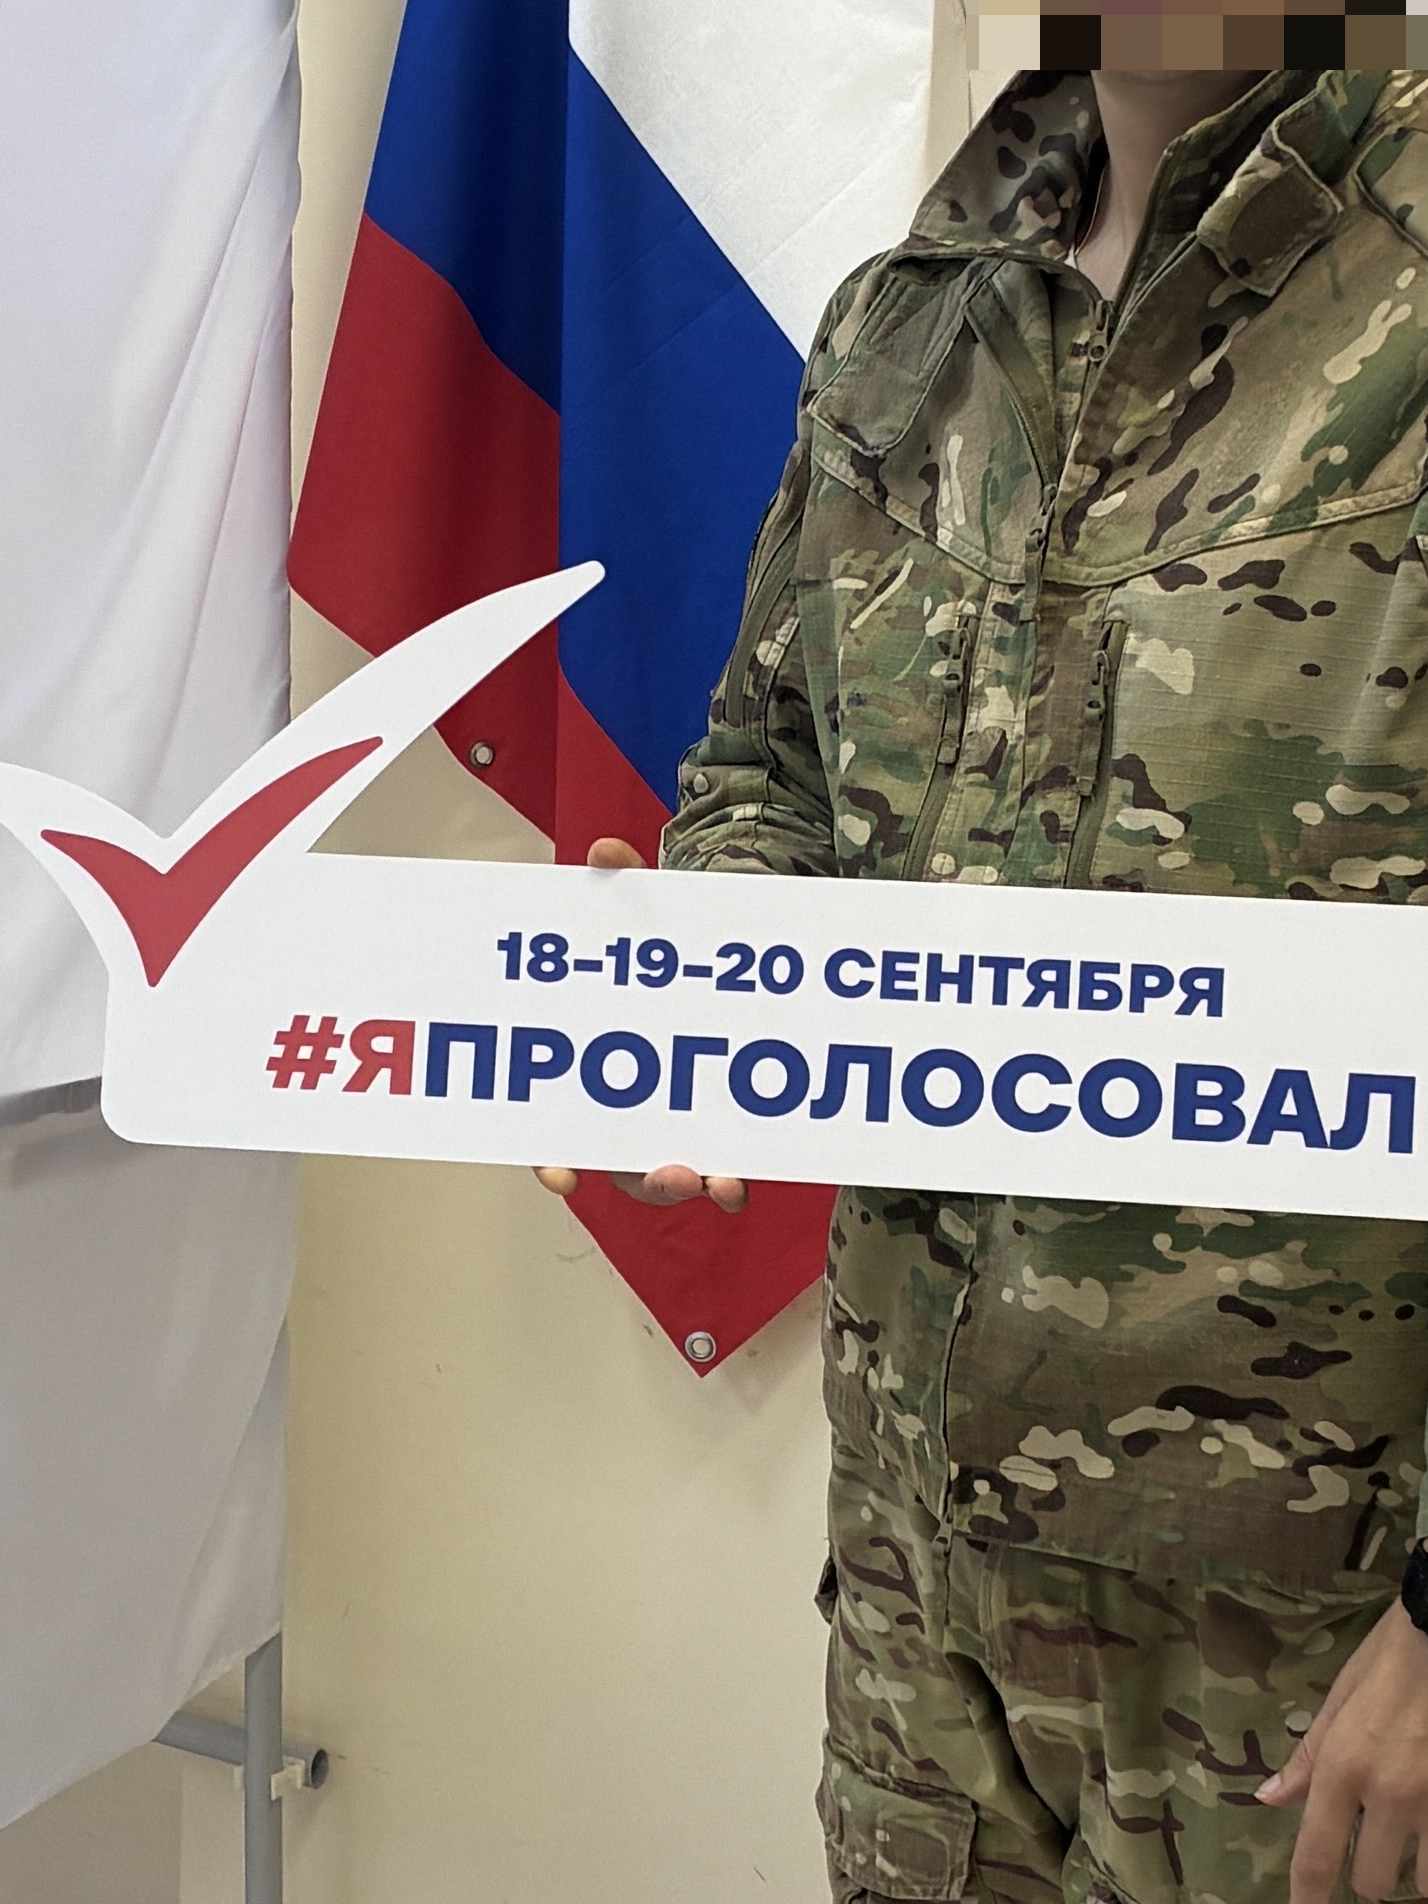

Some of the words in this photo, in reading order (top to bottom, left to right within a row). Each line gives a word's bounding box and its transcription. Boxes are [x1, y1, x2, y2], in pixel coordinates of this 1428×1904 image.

[498, 933, 803, 994] 18-19-20
[825, 949, 1223, 1016] СЕНТЯБРЯ
[267, 1016, 1415, 1153] #ЯПРОГОЛОСОВАЛ
